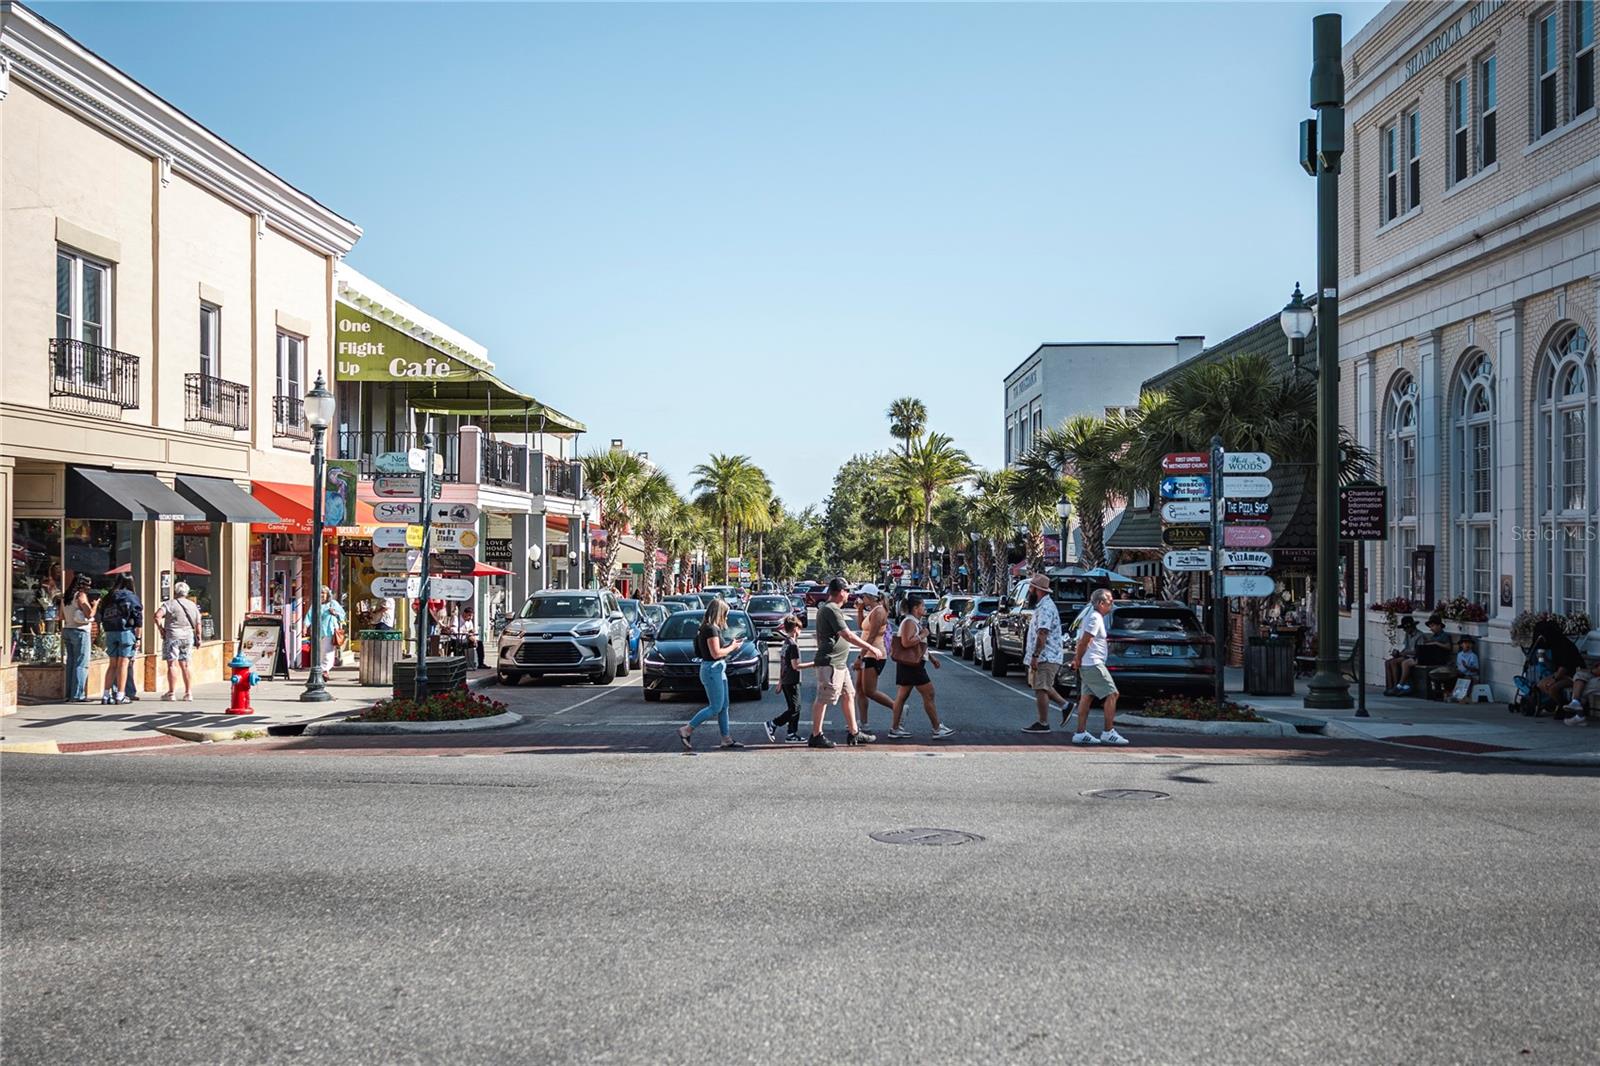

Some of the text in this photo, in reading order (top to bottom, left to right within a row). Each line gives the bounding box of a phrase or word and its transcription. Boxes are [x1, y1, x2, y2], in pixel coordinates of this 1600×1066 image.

[1406, 17, 1462, 80] SHAMROCK
[339, 319, 371, 332] One
[339, 342, 385, 357] Flight
[339, 362, 361, 376] Up
[389, 358, 451, 377] Café
[1227, 502, 1269, 513] THE PIZZA SHOP
[267, 523, 288, 531] Candy
